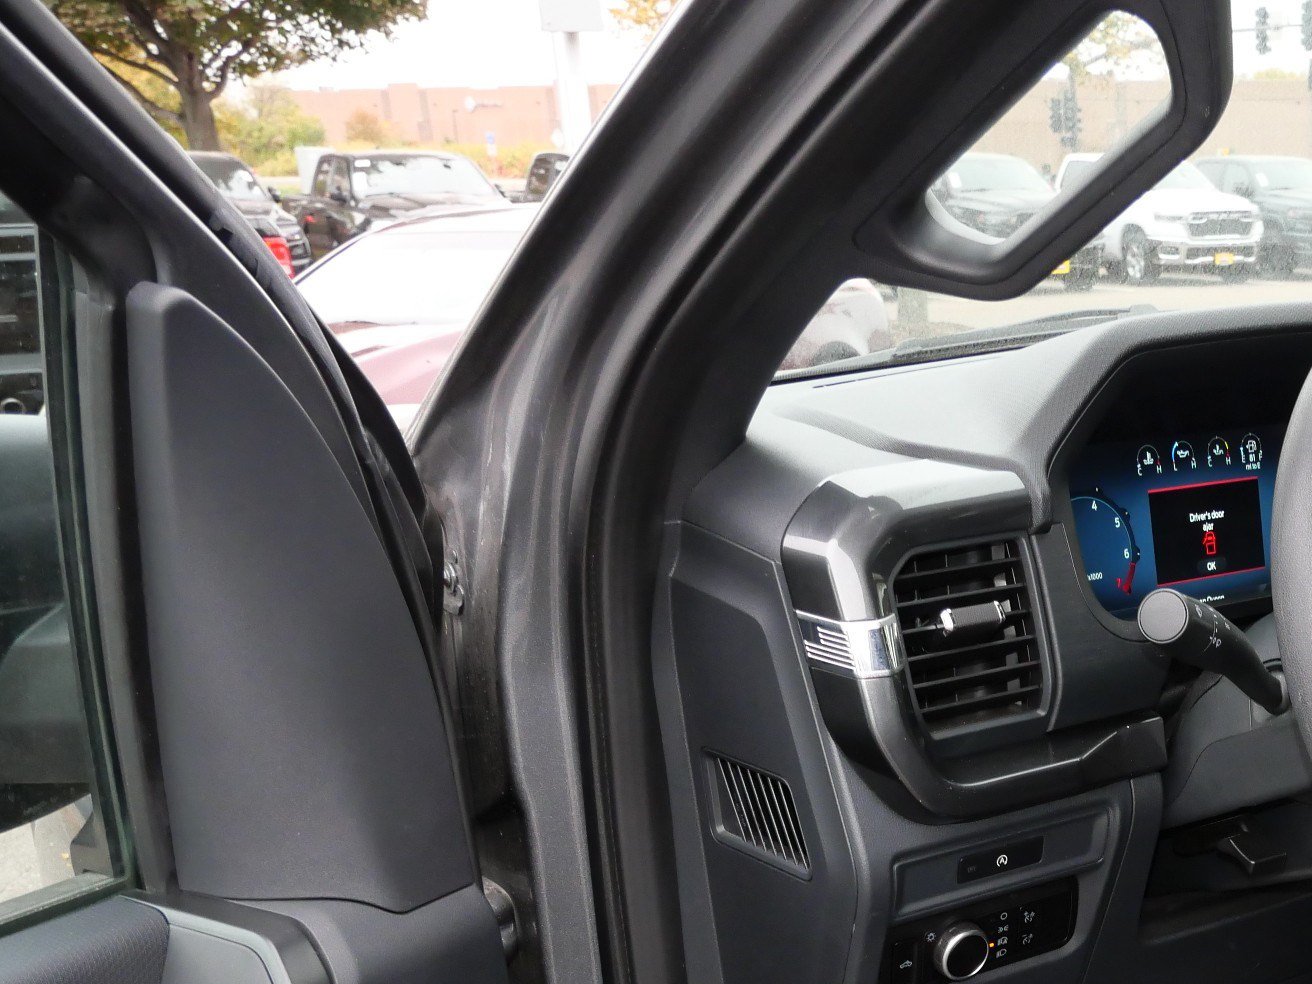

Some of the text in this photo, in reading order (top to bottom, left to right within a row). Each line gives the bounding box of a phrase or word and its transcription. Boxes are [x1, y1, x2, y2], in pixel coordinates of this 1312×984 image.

[1191, 460, 1196, 469] H
[1226, 456, 1231, 465] H
[1156, 464, 1162, 474] H
[1173, 463, 1177, 471] L
[1091, 501, 1098, 511] 4
[1189, 510, 1225, 522] Driver's door
[1114, 518, 1120, 528] 5
[1202, 522, 1214, 532] ajar
[1124, 549, 1129, 559] 6
[1207, 561, 1217, 570] OK
